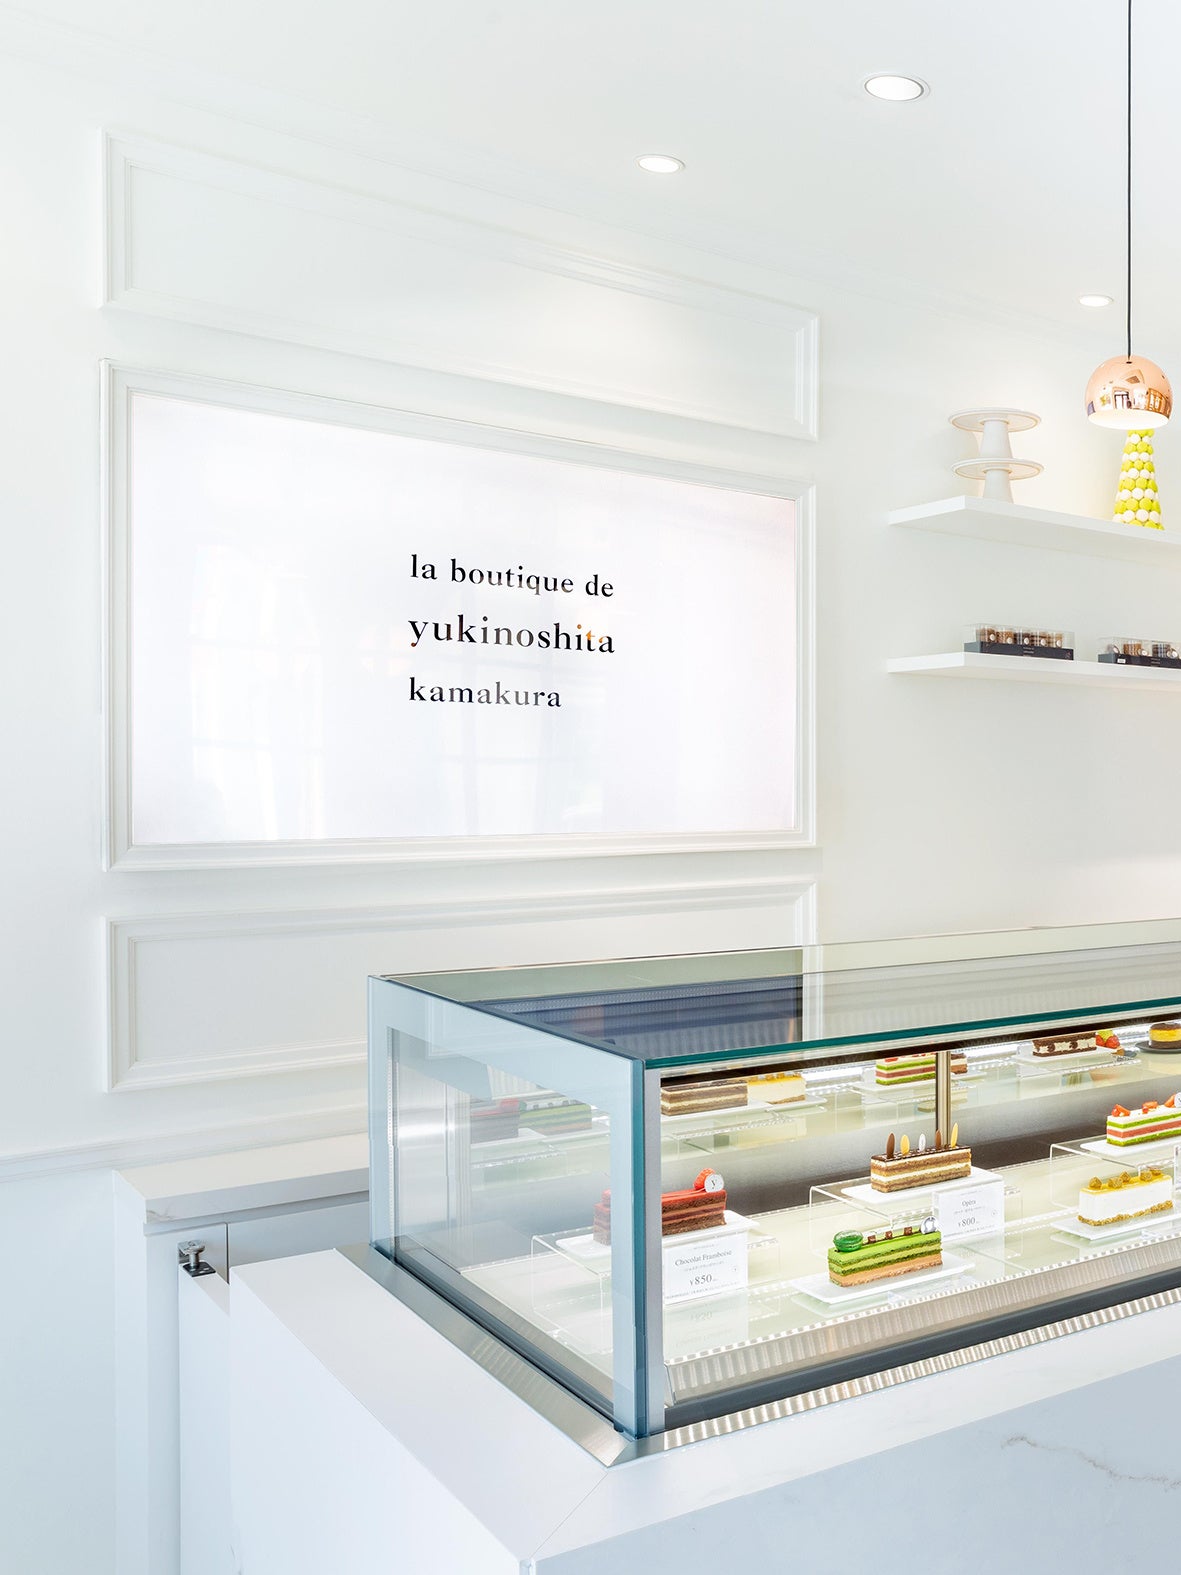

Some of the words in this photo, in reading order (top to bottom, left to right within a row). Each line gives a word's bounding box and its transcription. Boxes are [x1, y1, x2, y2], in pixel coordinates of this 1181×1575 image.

[410, 553, 438, 580] la
[450, 558, 574, 596] boutique
[585, 574, 614, 598] de
[408, 614, 616, 654] yukinoshita
[408, 676, 562, 707] kamakura
[675, 1255, 702, 1267] Chocolat
